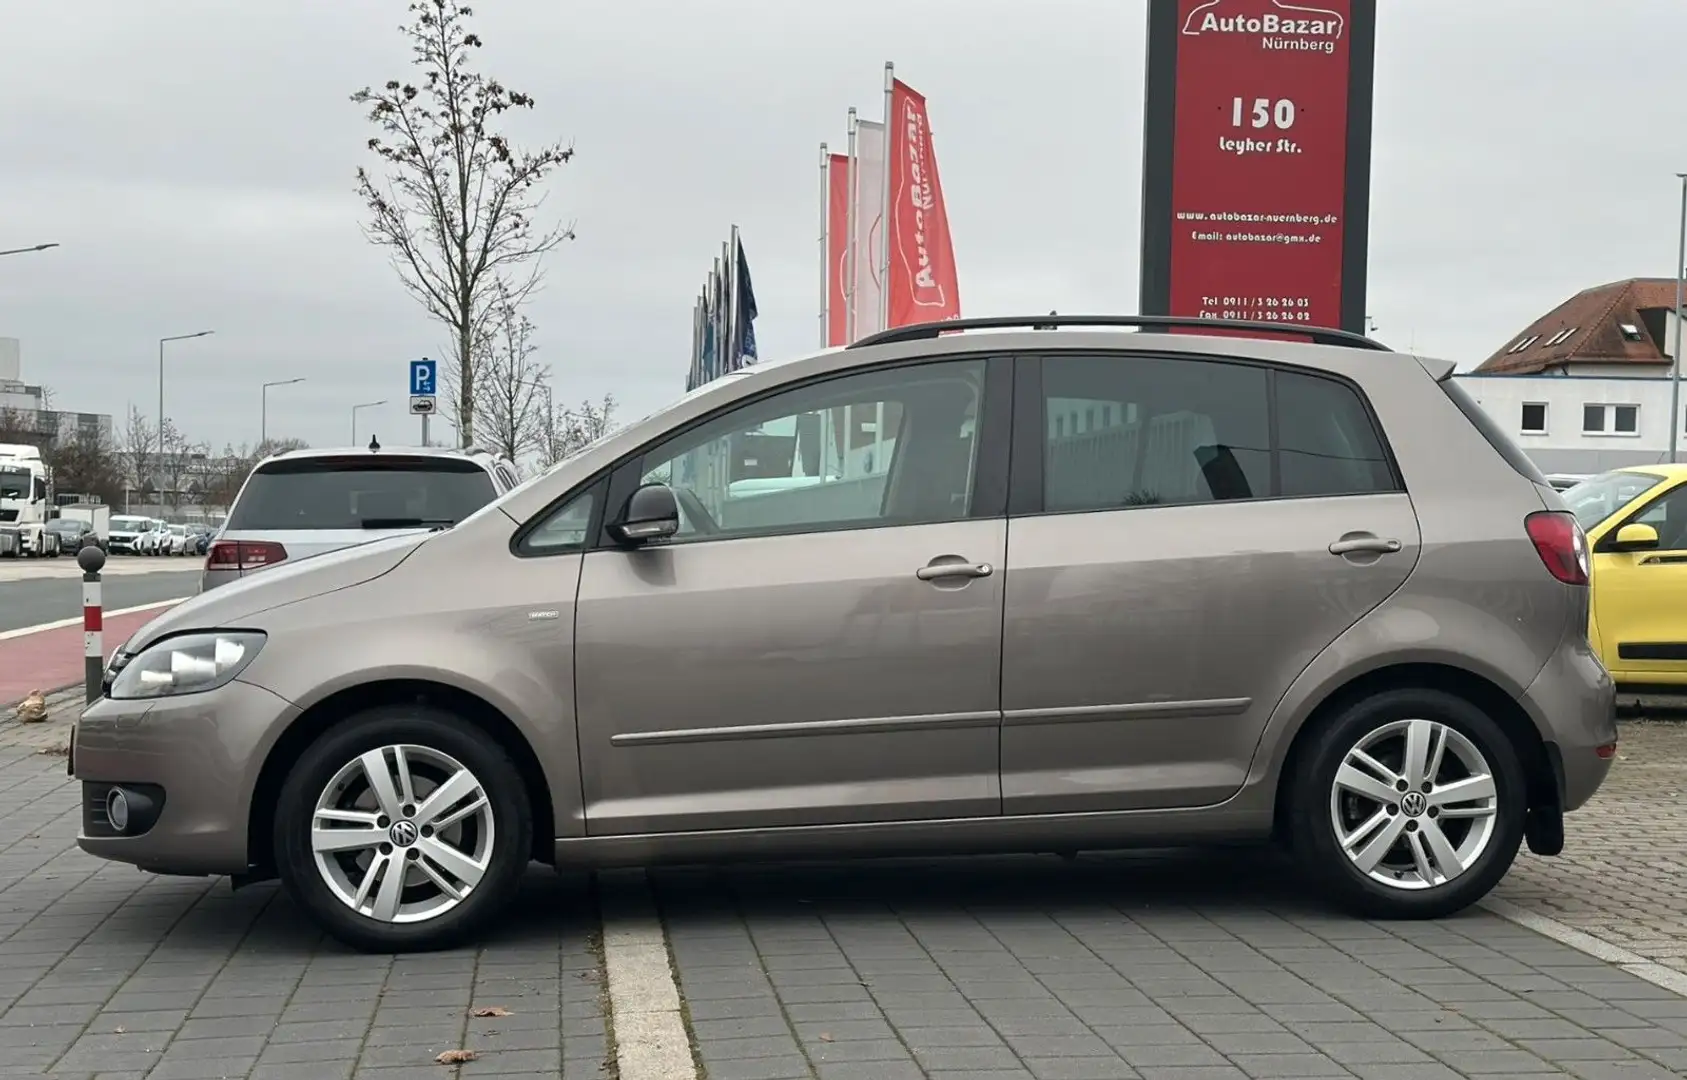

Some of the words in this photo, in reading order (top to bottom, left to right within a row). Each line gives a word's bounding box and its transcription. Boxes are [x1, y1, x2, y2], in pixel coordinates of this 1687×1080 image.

[1200, 12, 1337, 35] AutoBazar
[1262, 37, 1334, 54] Nürnberg
[1232, 97, 1295, 129] 150
[1275, 138, 1302, 153] Str.
[906, 105, 936, 288] AutoBazar
[1176, 211, 1338, 226] www.autobazar-nuernberg.de
[1191, 231, 1223, 241] Email:
[1225, 232, 1322, 244] autobazar@gmx.de
[1202, 296, 1218, 306] Tel
[416, 365, 430, 391] P
